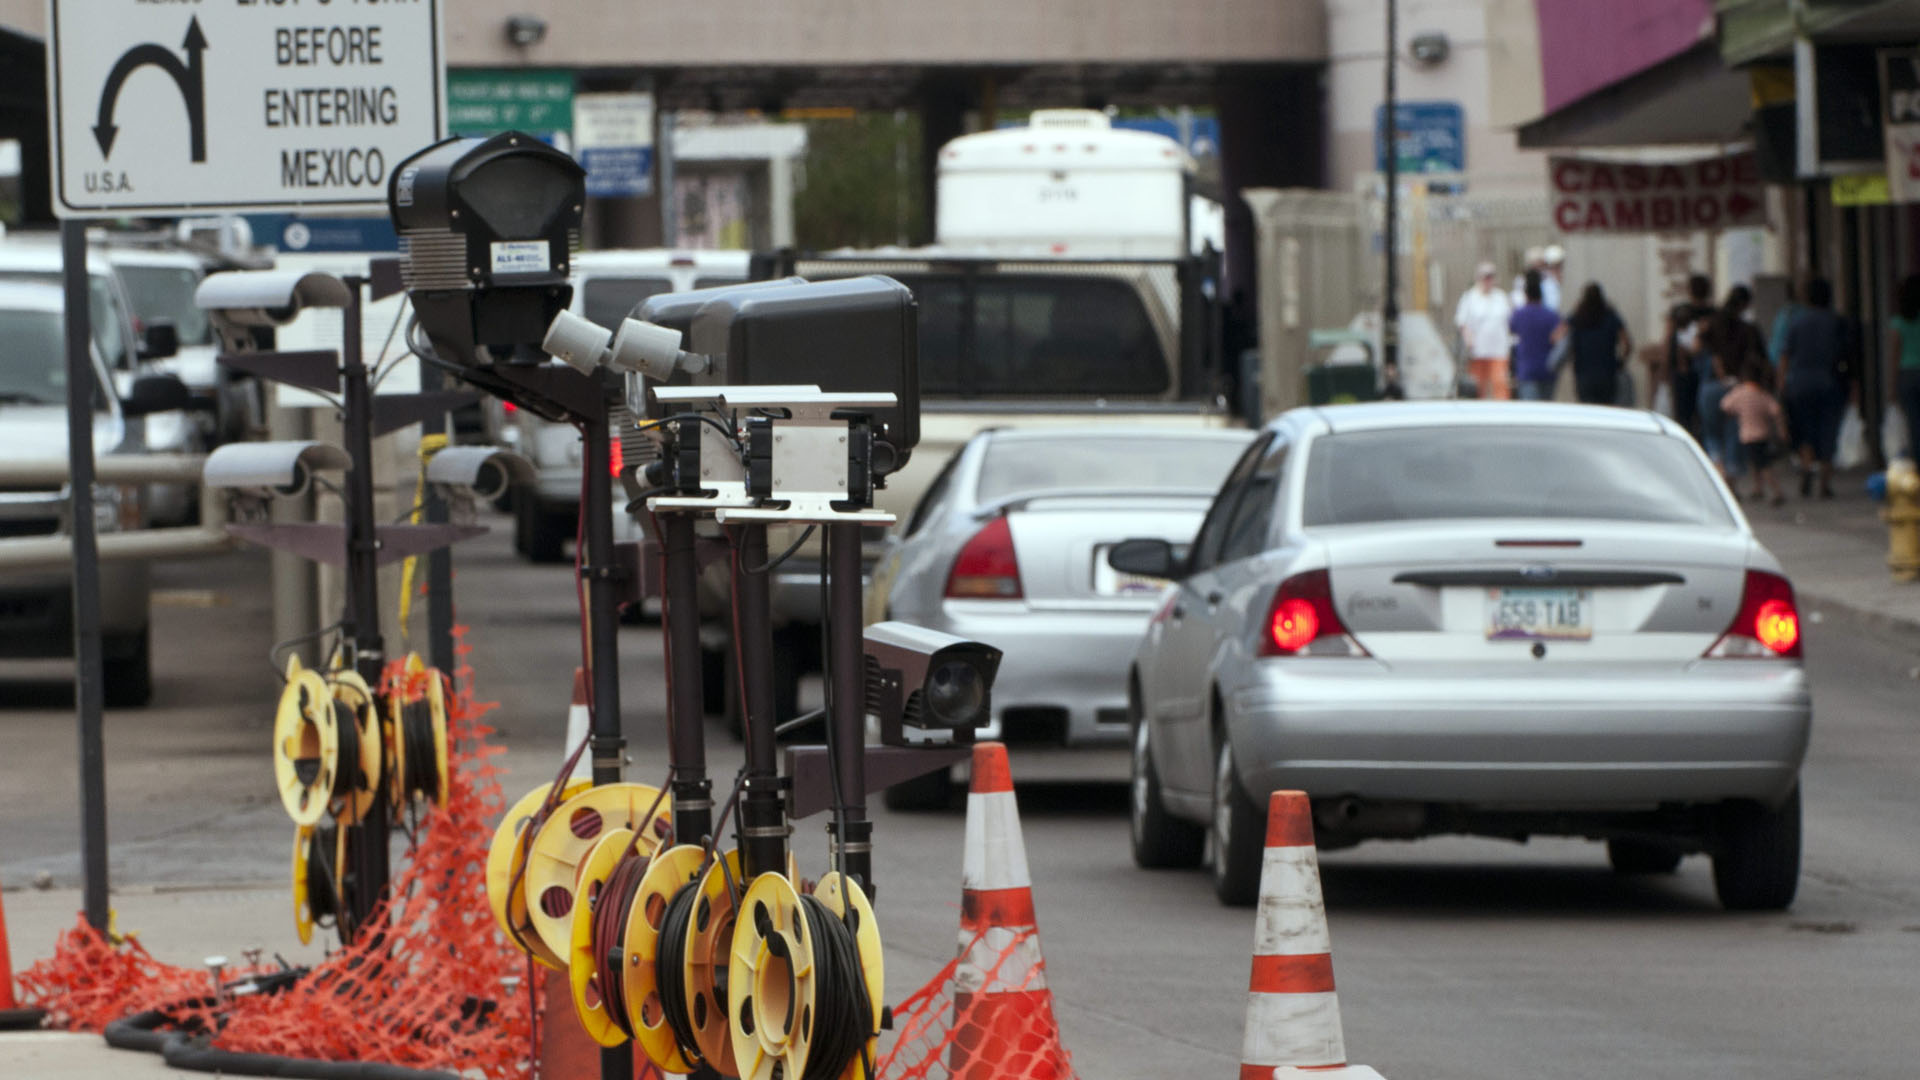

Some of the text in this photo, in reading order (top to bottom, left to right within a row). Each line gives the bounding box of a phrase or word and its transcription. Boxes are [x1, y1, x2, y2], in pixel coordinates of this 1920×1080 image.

[275, 26, 382, 65] BEFORE
[265, 86, 397, 126] ENTERING
[84, 170, 135, 193] U.S.A.
[281, 147, 384, 187] MEXICO
[1554, 160, 1687, 194] CASA
[1554, 194, 1722, 232] CAMBIO
